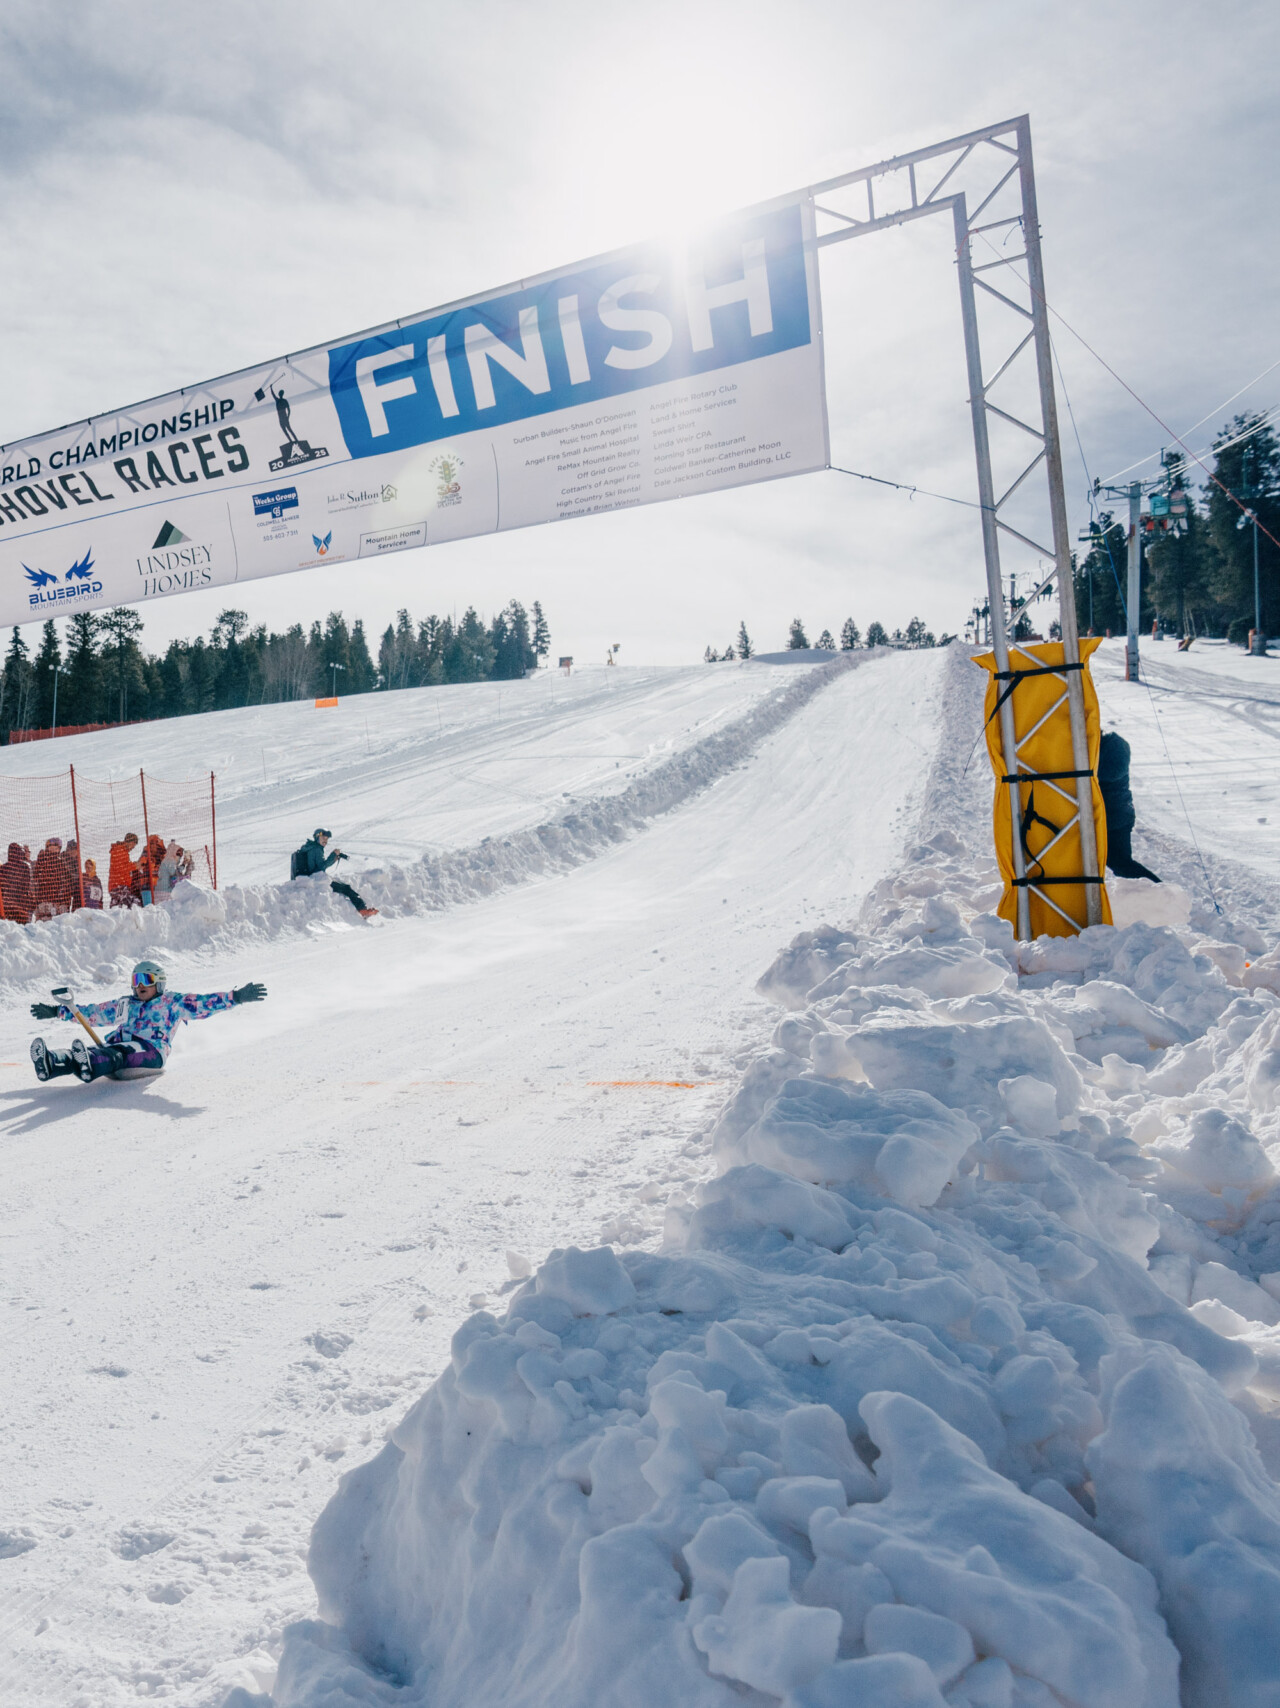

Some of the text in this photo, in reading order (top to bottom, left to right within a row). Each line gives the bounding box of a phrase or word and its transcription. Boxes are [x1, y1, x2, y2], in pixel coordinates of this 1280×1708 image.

[356, 235, 774, 439] FINISH
[650, 383, 738, 411] Angel Fire Rotary Club
[651, 413, 670, 424] Land
[679, 405, 702, 417] Home
[704, 397, 737, 411] Services
[49, 398, 235, 470] CHAMPIONSHIP
[513, 409, 637, 444] Durban Builders-Shaun O'Donovan
[559, 422, 638, 446] Music from Angel Fire
[652, 421, 696, 437] Sweet Shirt
[525, 434, 640, 466] Angel Fire Small Animal Hospital
[653, 430, 712, 450] Linda Weir CPA
[654, 435, 746, 463] Morning Star Restaurant
[113, 426, 250, 493] RACES
[271, 460, 284, 470] 20
[314, 449, 327, 458] 25
[557, 448, 641, 472] ReMax Mountain Realty
[654, 440, 782, 475] Coldwell Banker-Catherine Moon
[577, 471, 589, 480] Off
[590, 468, 606, 477] Grid
[608, 464, 627, 473] Grow
[654, 451, 792, 488] Dale Jackson Custom Building, LLC
[561, 472, 641, 495] Cottam's of Angel Fire
[254, 497, 275, 506] Weeks
[275, 492, 297, 502] Group
[346, 490, 379, 504] Sutton
[556, 485, 641, 508] High Country Ski Rental
[559, 508, 585, 518] Brenda
[593, 502, 613, 511] Brian
[365, 528, 421, 545] Mountain Home
[377, 540, 407, 550] Services
[136, 543, 213, 576] LINDSEY
[28, 581, 103, 605] BLUEBIRD
[144, 567, 211, 596] HOMES
[29, 591, 104, 612] MOUNTAIN SPORTS
